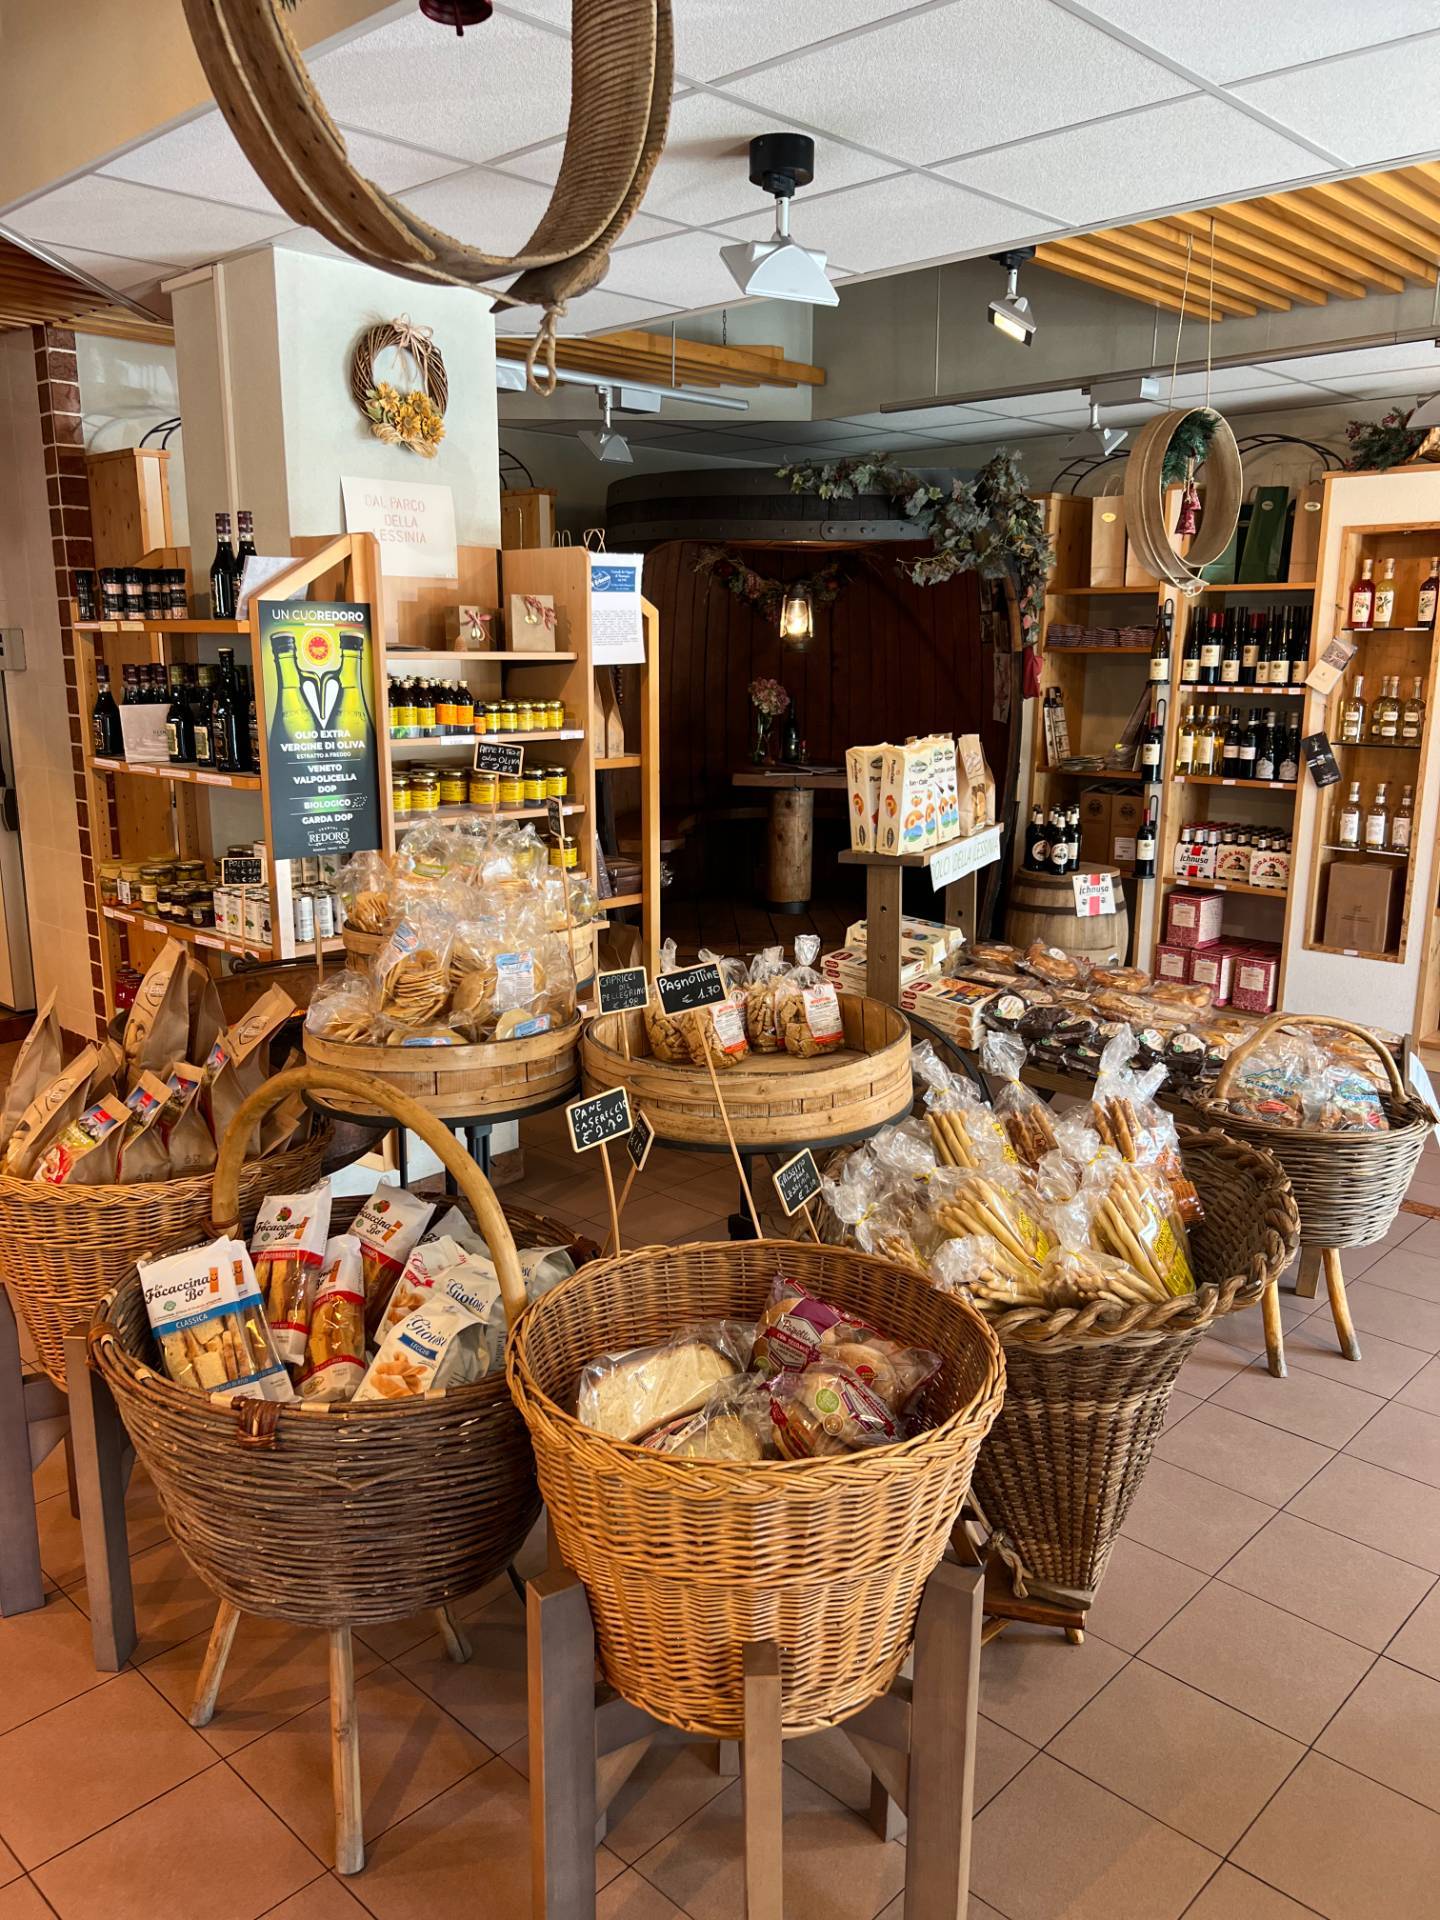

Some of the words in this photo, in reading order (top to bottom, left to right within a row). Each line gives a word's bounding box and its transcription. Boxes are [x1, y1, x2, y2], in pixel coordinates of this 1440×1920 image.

[365, 494, 386, 507] DAL
[391, 496, 425, 513] PARCO
[384, 514, 418, 528] DELLA
[271, 608, 290, 620] UN
[292, 609, 364, 622] CUOREDORO
[294, 730, 319, 740] OLIO
[320, 729, 351, 739] EXTRA
[280, 742, 324, 752] VERGINE
[325, 742, 335, 750] DI
[337, 740, 366, 750] OLIVA
[296, 752, 324, 760] ESTRATTO
[307, 764, 343, 773] VENETO
[293, 774, 358, 785] VALPOLICELLA
[317, 785, 337, 793] DOP
[303, 798, 351, 810] BIOLOGICO
[301, 814, 333, 825] GARDA
[334, 813, 354, 822] DOP
[308, 830, 350, 844] REDORO
[1180, 854, 1209, 865] Ichnusa
[1217, 853, 1233, 869] BIRRA
[1079, 885, 1110, 896] Ichnusa
[599, 972, 636, 988] CAPRICCI
[697, 985, 721, 1000] 1.70
[574, 1100, 602, 1121] PANE
[574, 1100, 627, 1133] CASERECCIO
[582, 1129, 593, 1144] €
[254, 1222, 301, 1235] Focaccina
[144, 1275, 210, 1304] Focaccina
[446, 1278, 489, 1313] Gioiosi
[175, 1313, 209, 1329] CLASSICA
[406, 1314, 452, 1347] Gioiosi
